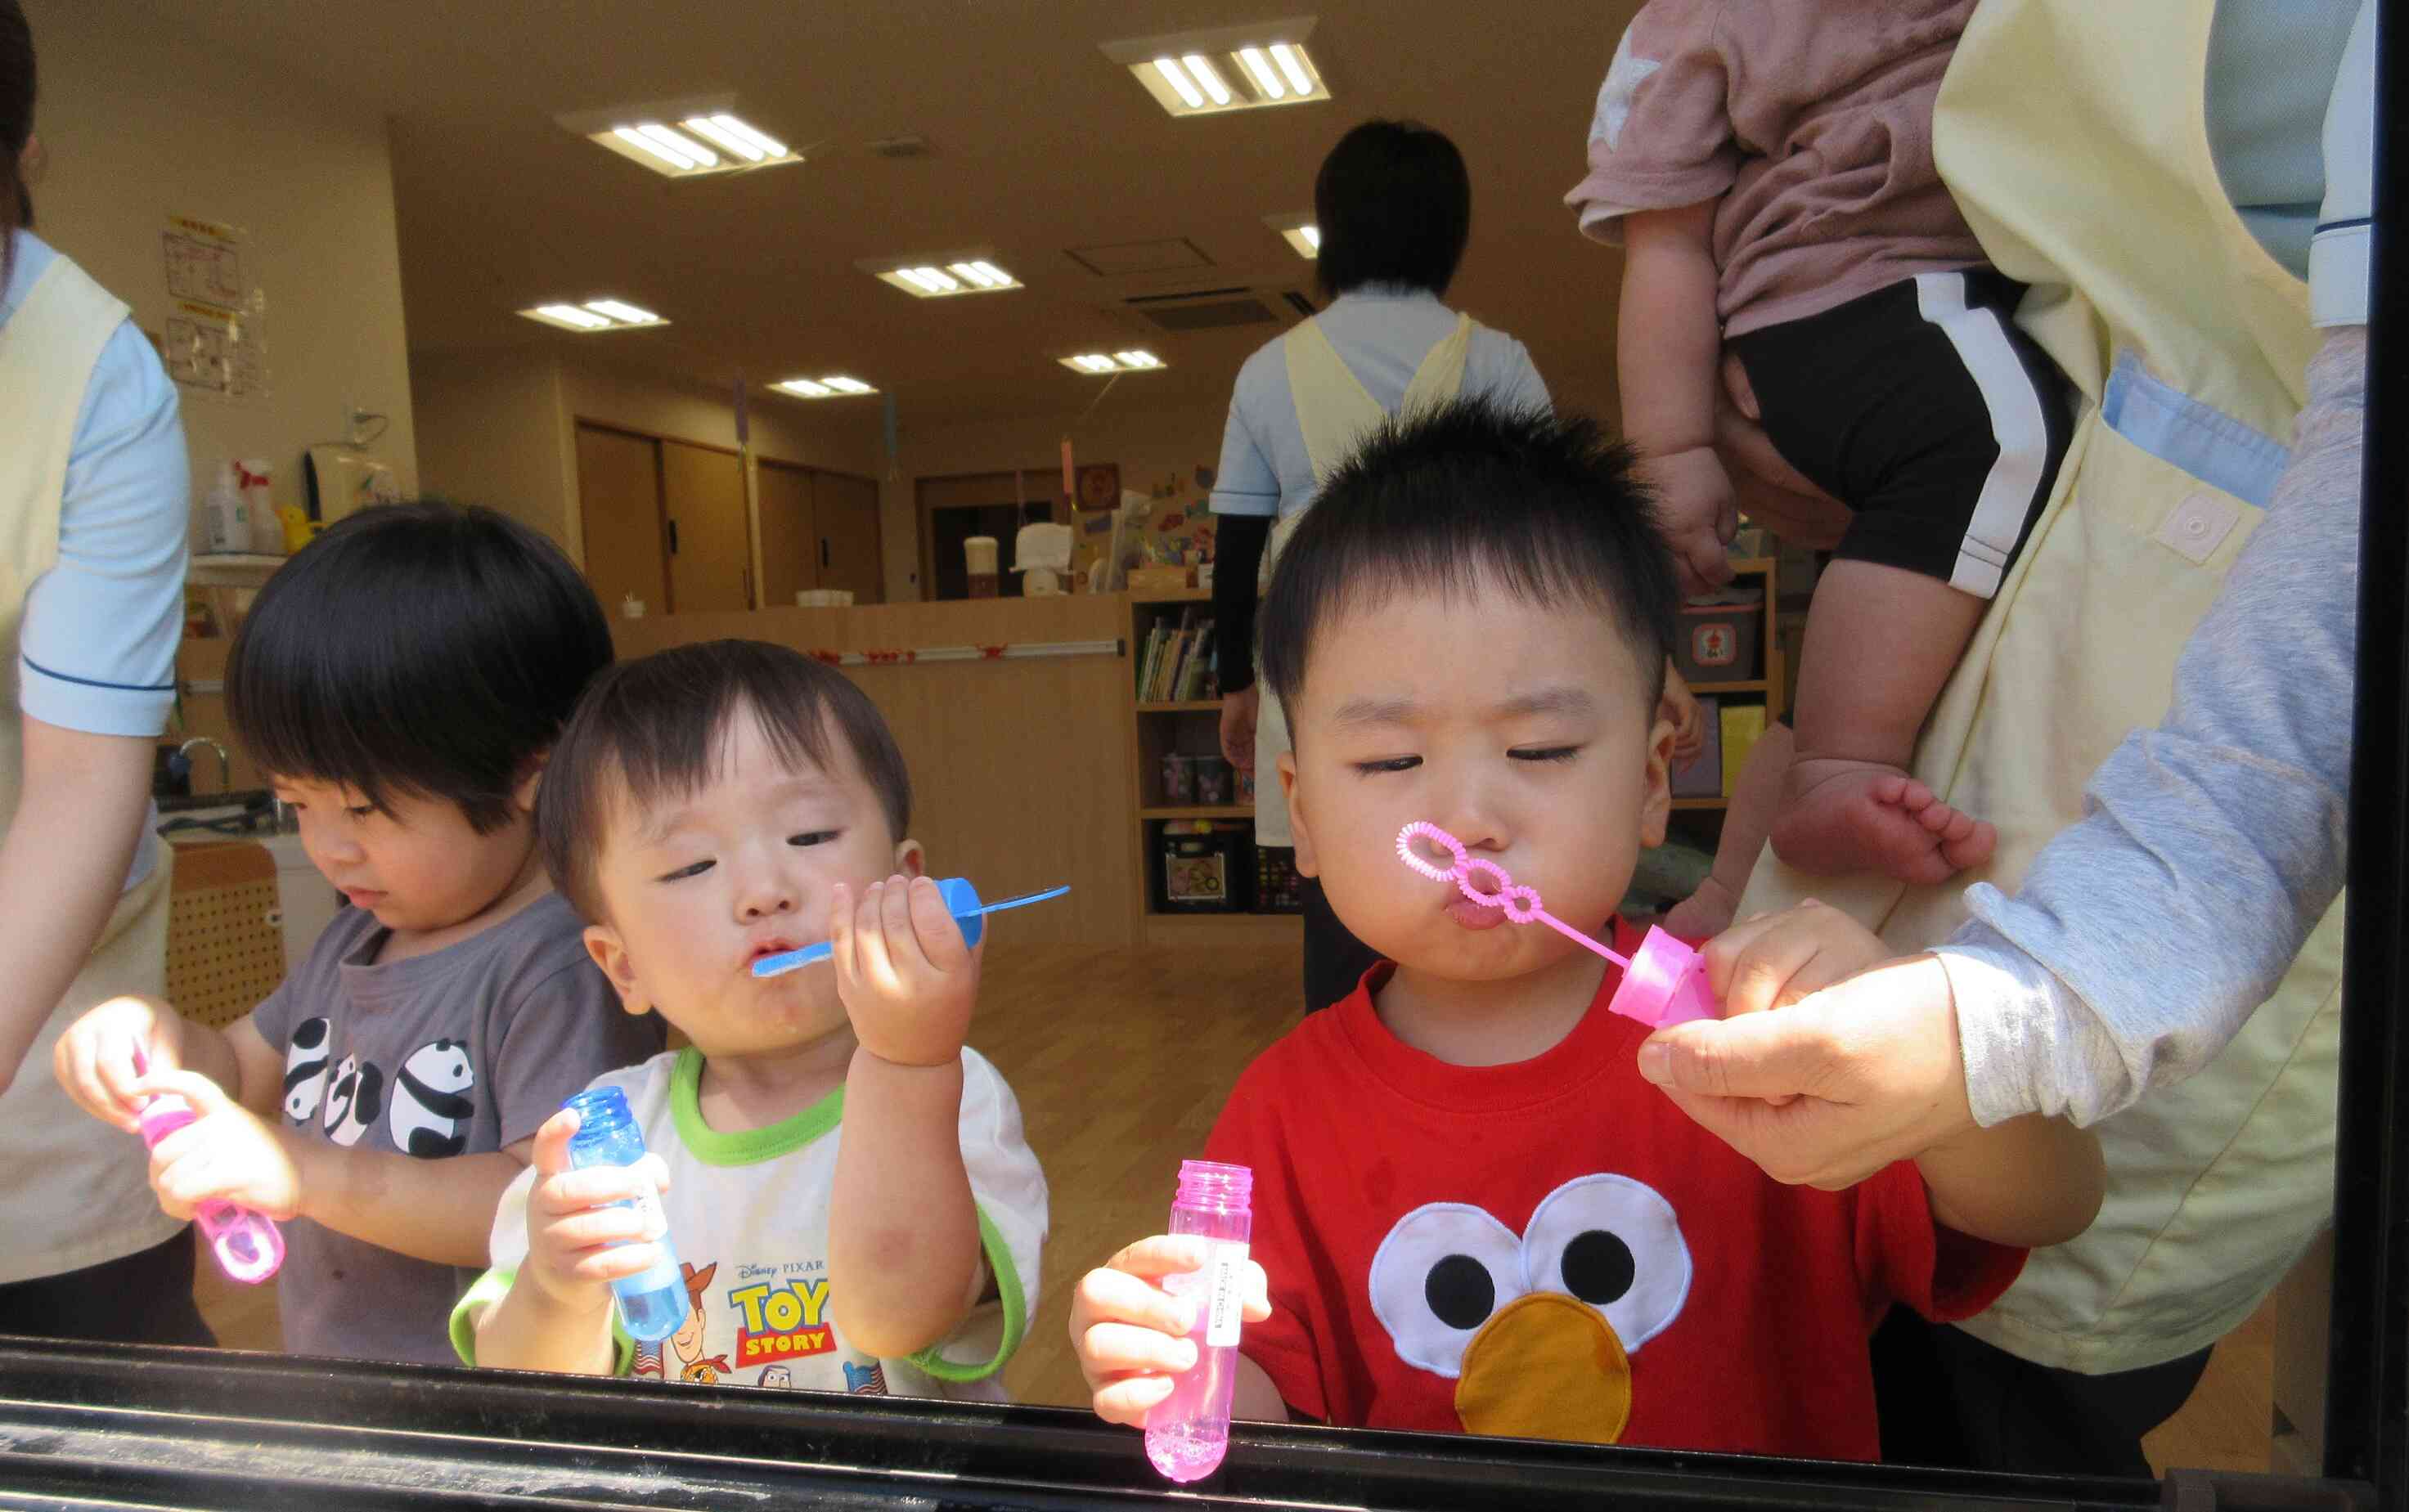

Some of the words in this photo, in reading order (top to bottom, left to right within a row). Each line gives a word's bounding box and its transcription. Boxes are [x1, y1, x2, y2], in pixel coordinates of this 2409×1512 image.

[735, 1263, 778, 1279] Disney
[783, 1260, 825, 1273] PIXAR
[727, 1278, 830, 1337] TOY
[745, 1331, 825, 1356] STORY
